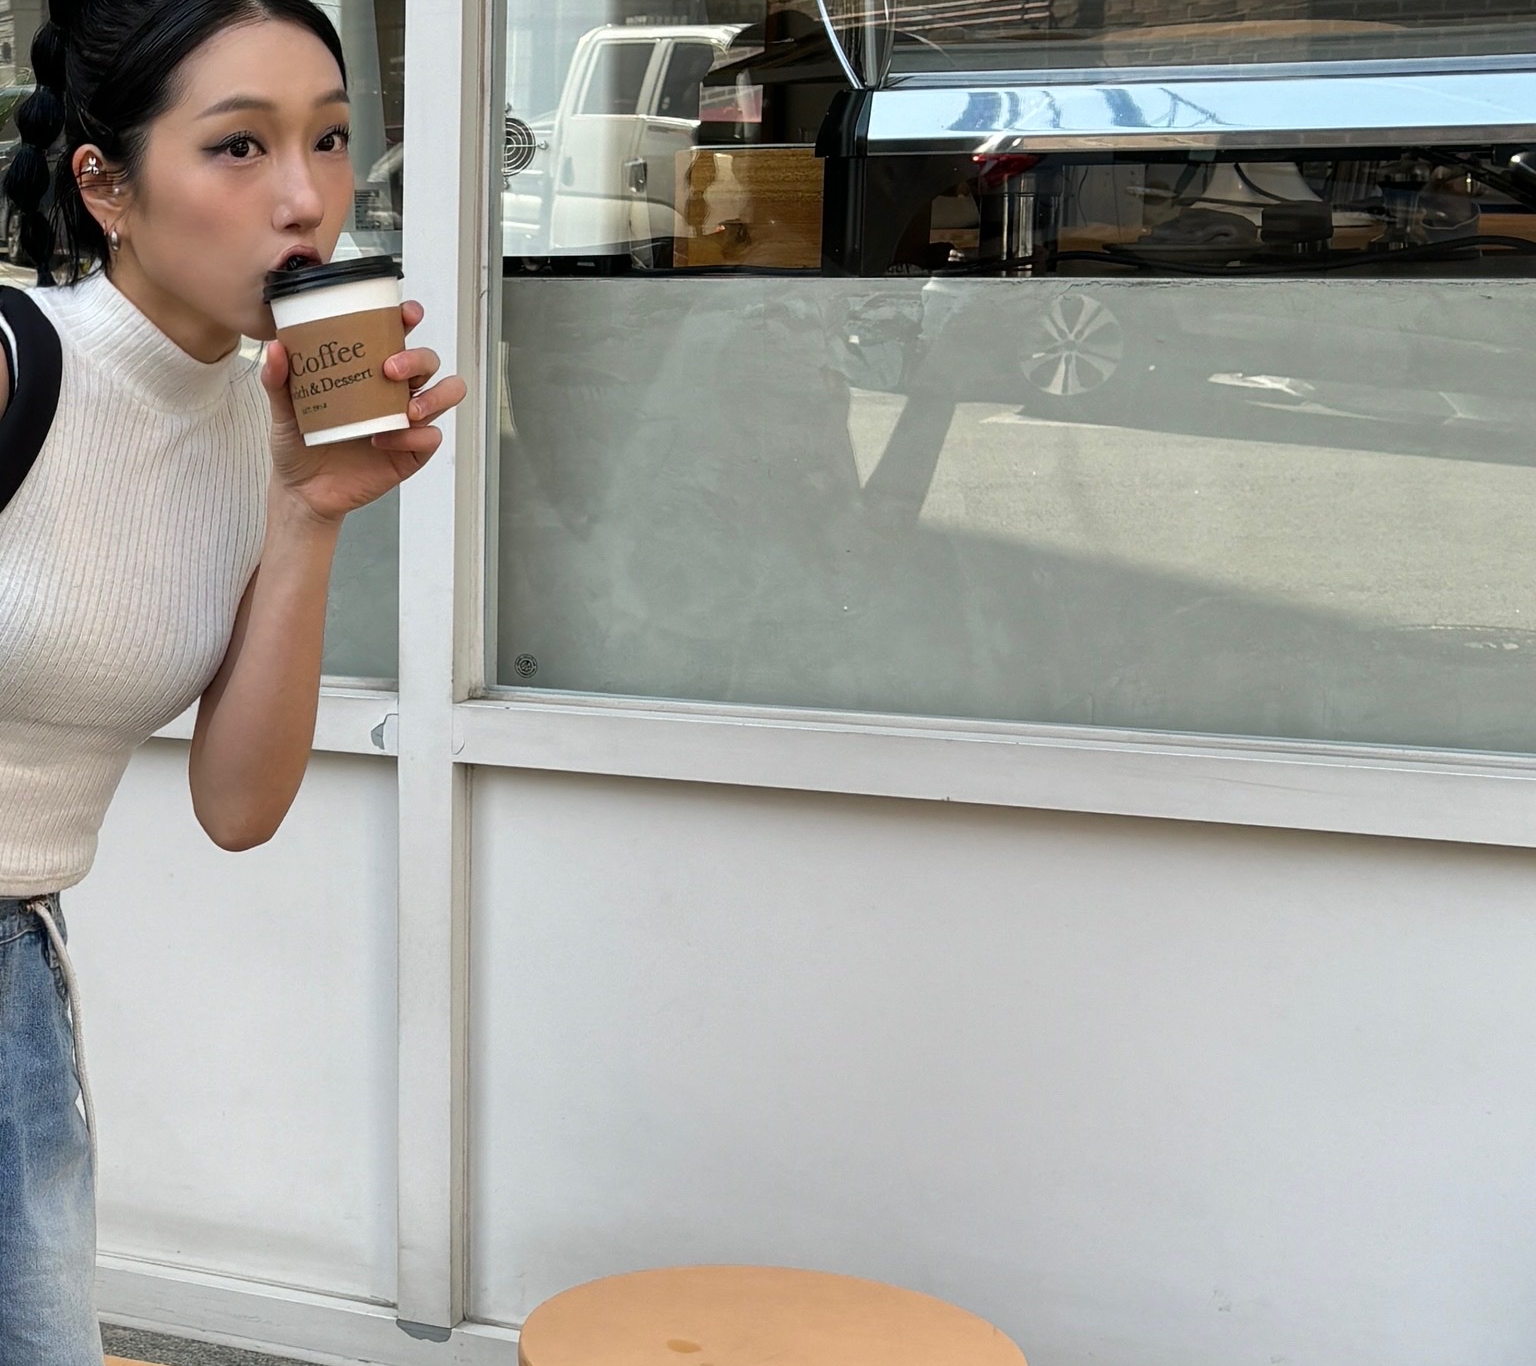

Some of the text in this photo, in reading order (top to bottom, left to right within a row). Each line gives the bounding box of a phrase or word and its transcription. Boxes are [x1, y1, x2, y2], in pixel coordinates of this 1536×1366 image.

[290, 340, 367, 378] Coffee
[310, 382, 321, 396] &
[320, 368, 374, 392] Dessert
